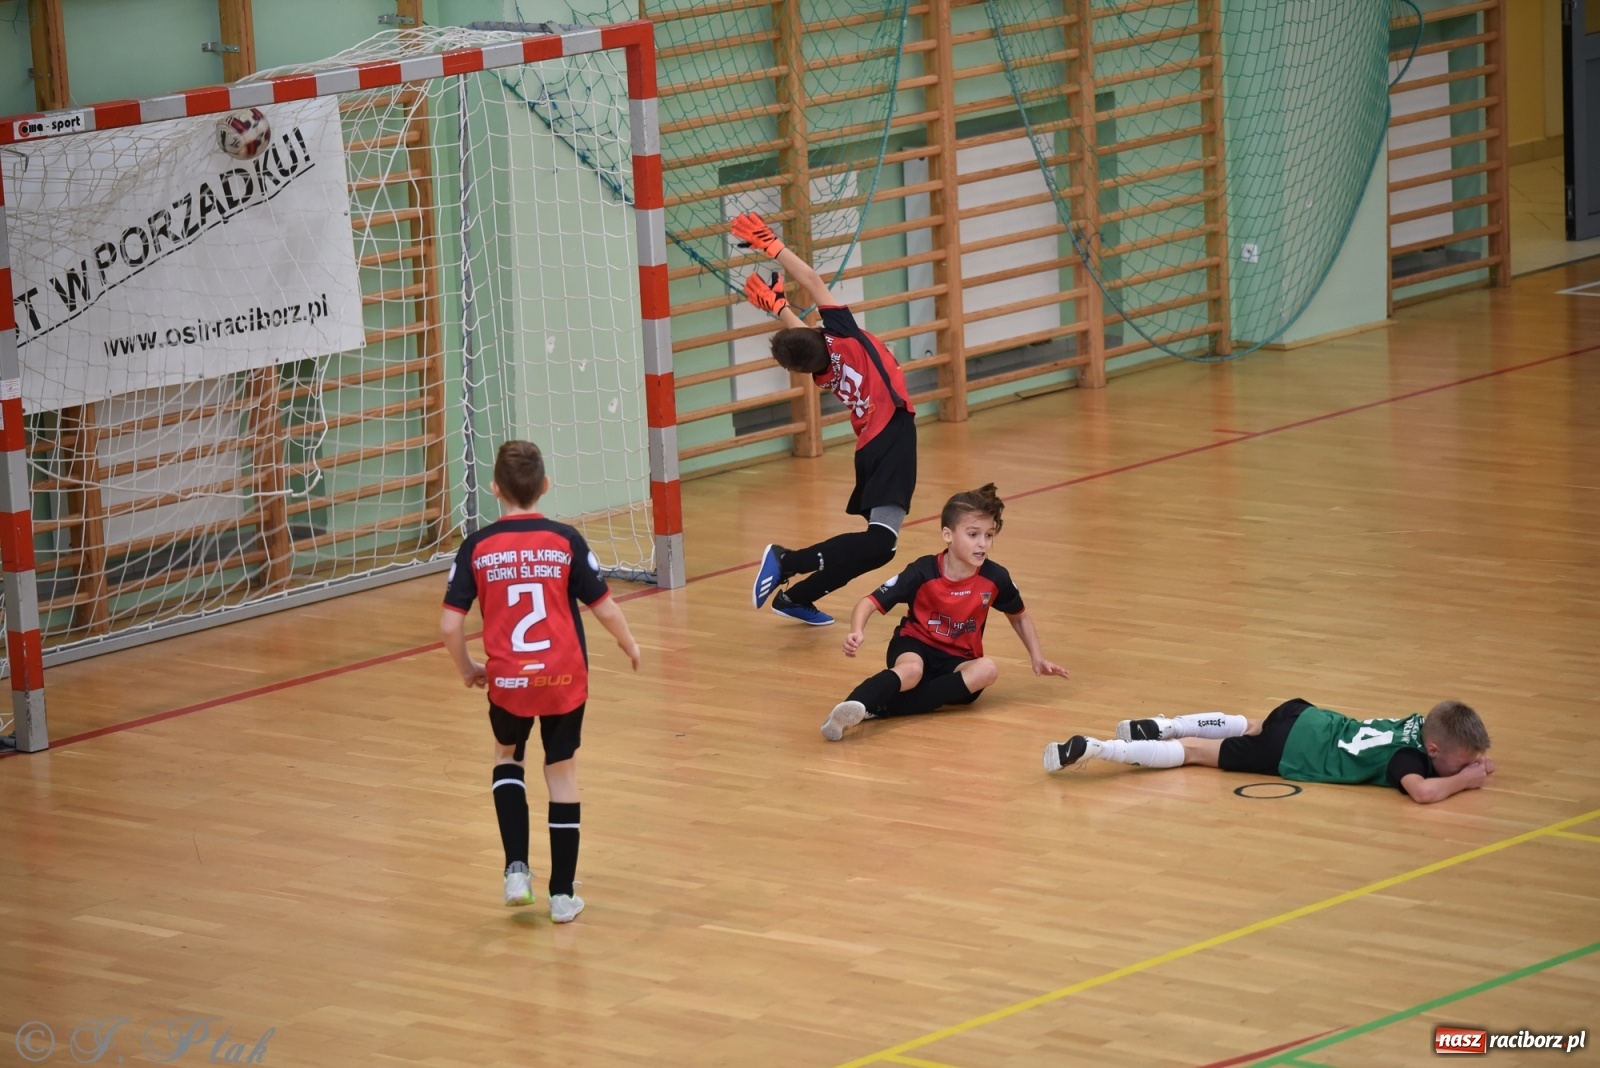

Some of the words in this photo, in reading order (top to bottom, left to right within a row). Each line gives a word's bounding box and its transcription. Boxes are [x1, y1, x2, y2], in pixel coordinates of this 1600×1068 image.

[49, 259, 91, 312] W
[487, 565, 518, 583] GÓRKI
[507, 582, 551, 653] 2
